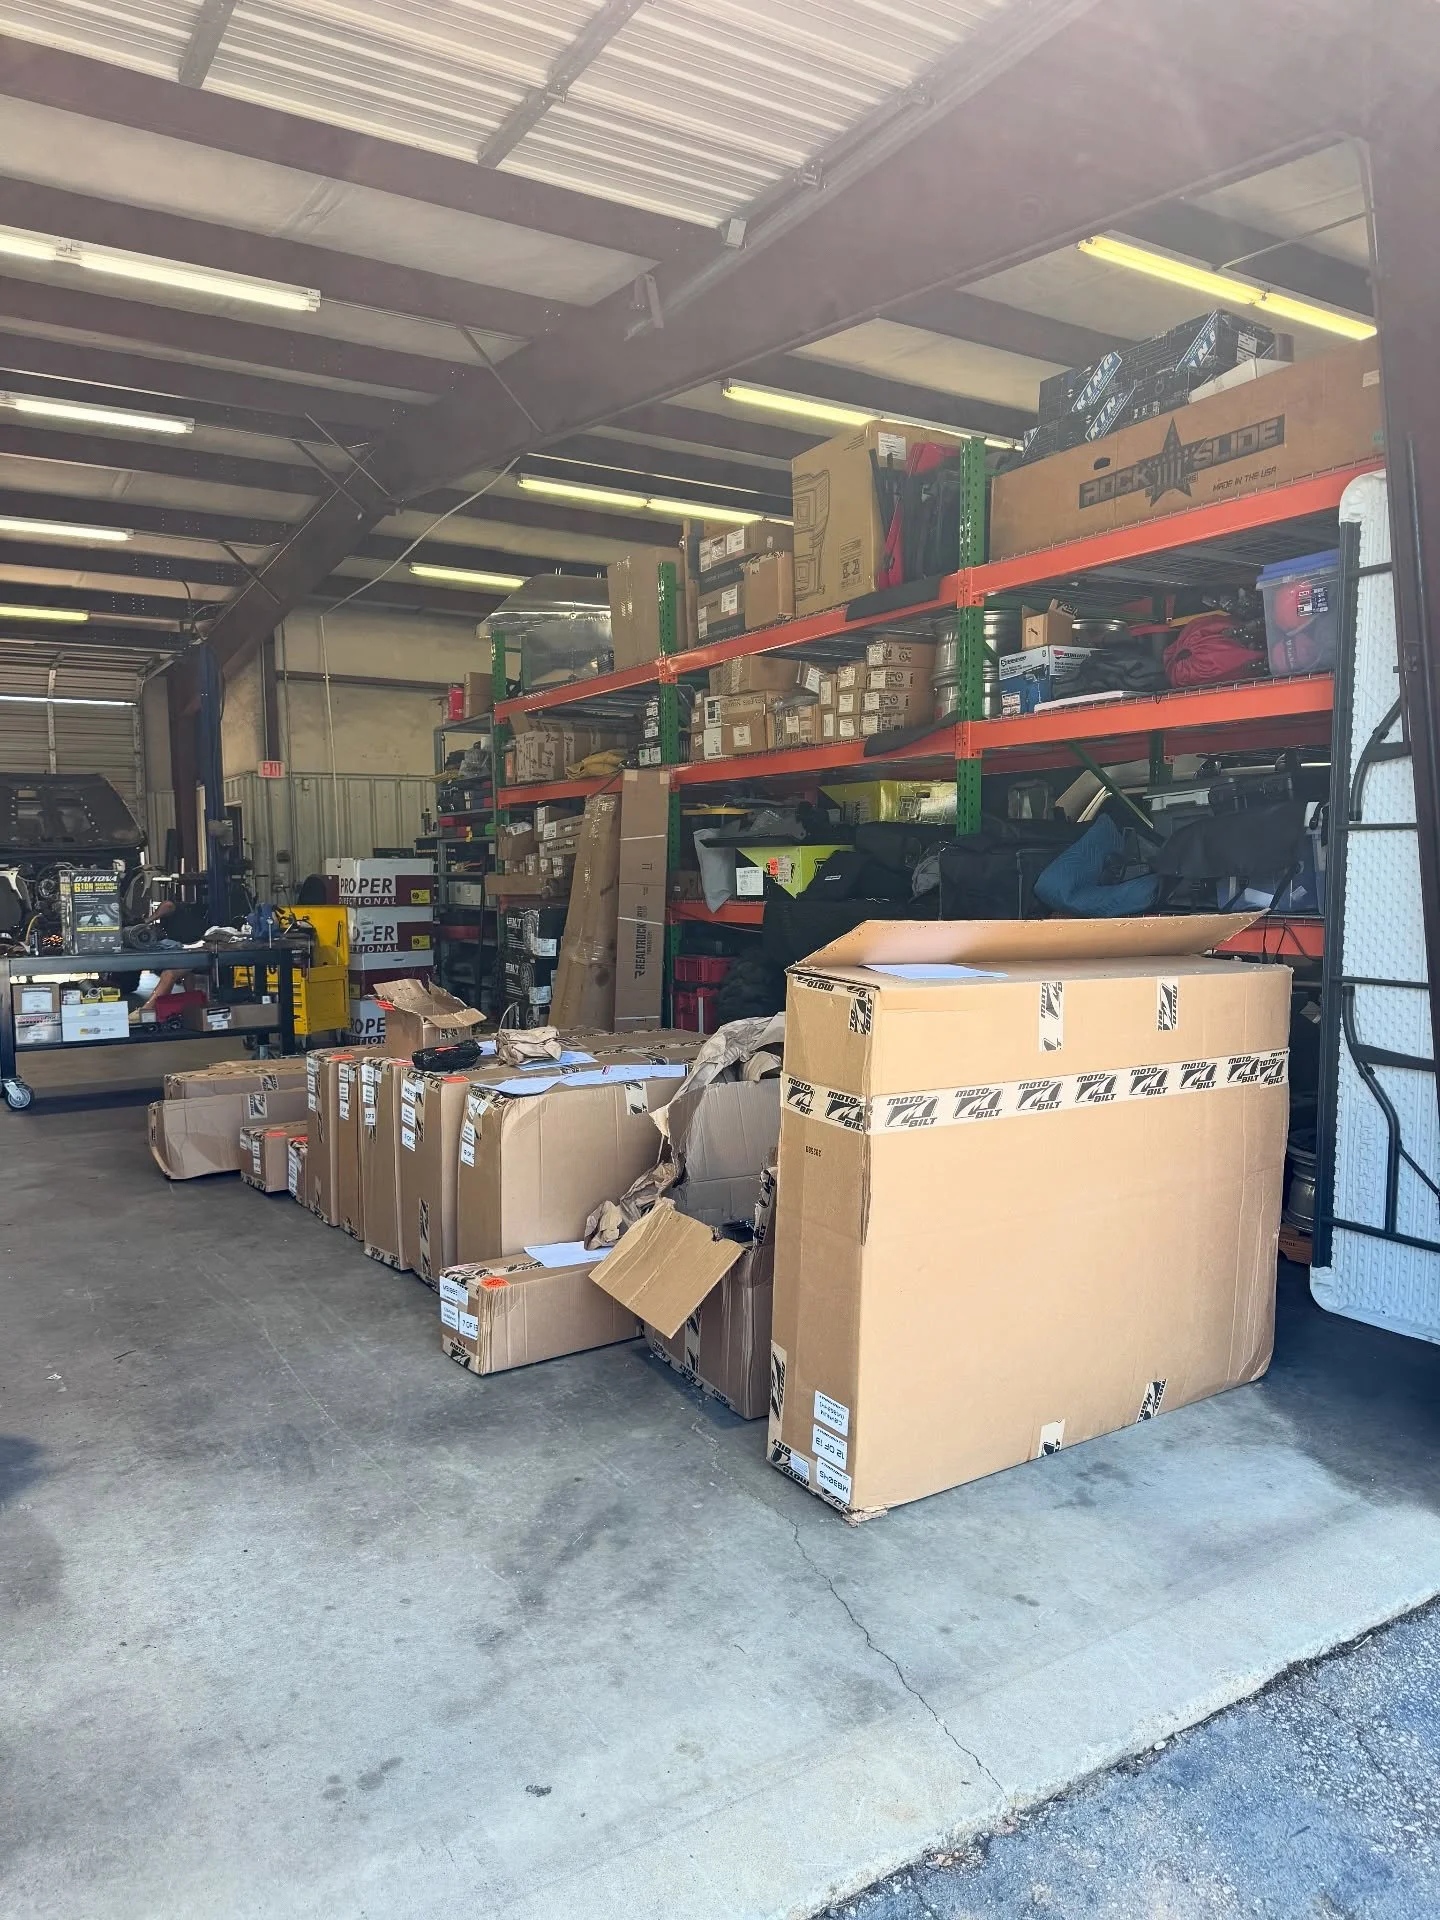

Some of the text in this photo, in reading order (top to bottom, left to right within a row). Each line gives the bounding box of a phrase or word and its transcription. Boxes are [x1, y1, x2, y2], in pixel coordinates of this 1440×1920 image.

[1076, 353, 1115, 410] KING
[1192, 417, 1280, 468] SLIDE
[1083, 461, 1150, 507] ROCK
[1213, 466, 1277, 491] MADE IN THE USA
[262, 762, 282, 777] EXIT
[340, 877, 393, 894] PROPER
[635, 923, 647, 970] REALTRUCK
[1228, 1055, 1251, 1064] MOTO
[1181, 1061, 1207, 1070] MOTO
[1130, 1067, 1158, 1076] MOTO
[1076, 1073, 1106, 1083] MOTO
[1241, 1074, 1260, 1083] BILT
[1268, 1075, 1285, 1085] BILT
[787, 1077, 812, 1091] MOTO
[1018, 1080, 1051, 1090] MOTO
[1195, 1080, 1217, 1089] BILT
[955, 1087, 990, 1098] MOTO
[1146, 1087, 1169, 1096] BILT
[827, 1090, 858, 1105] MOTO
[887, 1095, 924, 1106] MOTO
[1094, 1093, 1117, 1103] BILT
[1036, 1101, 1062, 1111] BILT
[975, 1109, 1003, 1119] BILT
[908, 1117, 938, 1128] BILT
[449, 1341, 466, 1354] MOTO
[771, 1438, 792, 1453] BILT
[815, 1436, 823, 1447] 13
[824, 1443, 835, 1454] OF
[836, 1450, 846, 1461] 12
